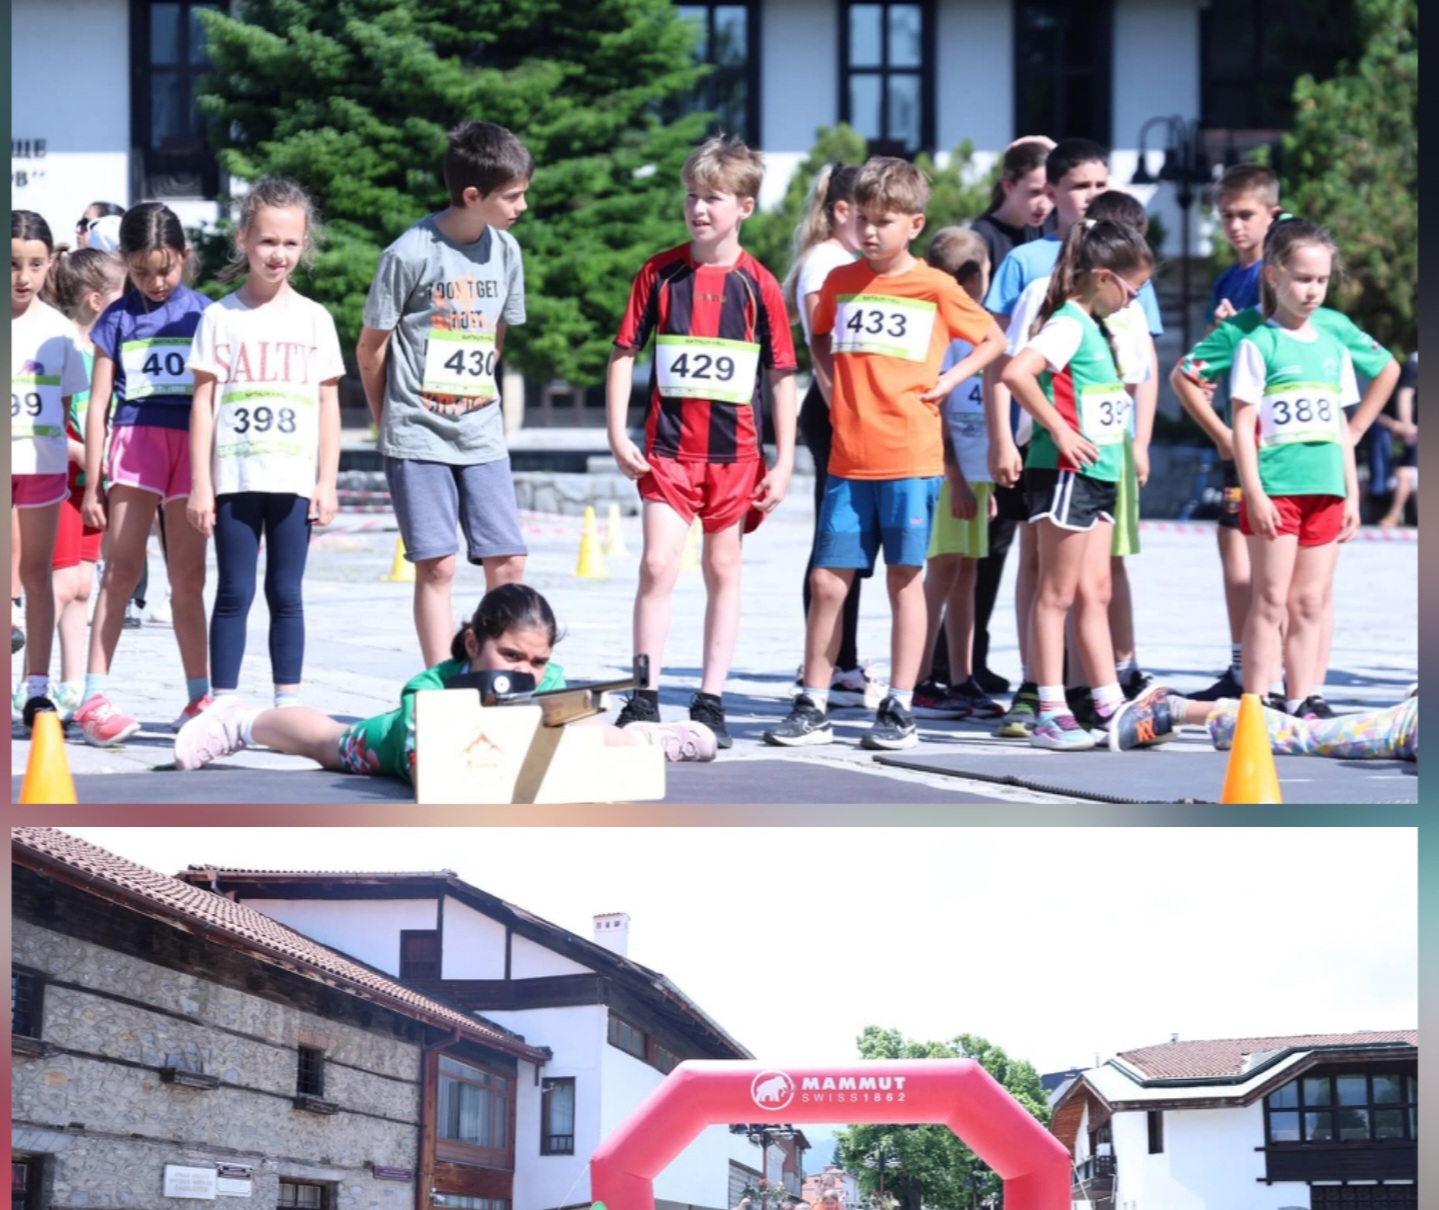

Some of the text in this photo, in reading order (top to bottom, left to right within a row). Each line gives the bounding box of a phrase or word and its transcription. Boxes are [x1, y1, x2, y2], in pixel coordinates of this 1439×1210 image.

[847, 310, 907, 338] 433
[215, 341, 318, 385] SALTY
[670, 353, 735, 382] 429
[233, 406, 296, 434] 398
[1272, 398, 1332, 425] 388
[801, 1077, 906, 1091] MAMMUT
